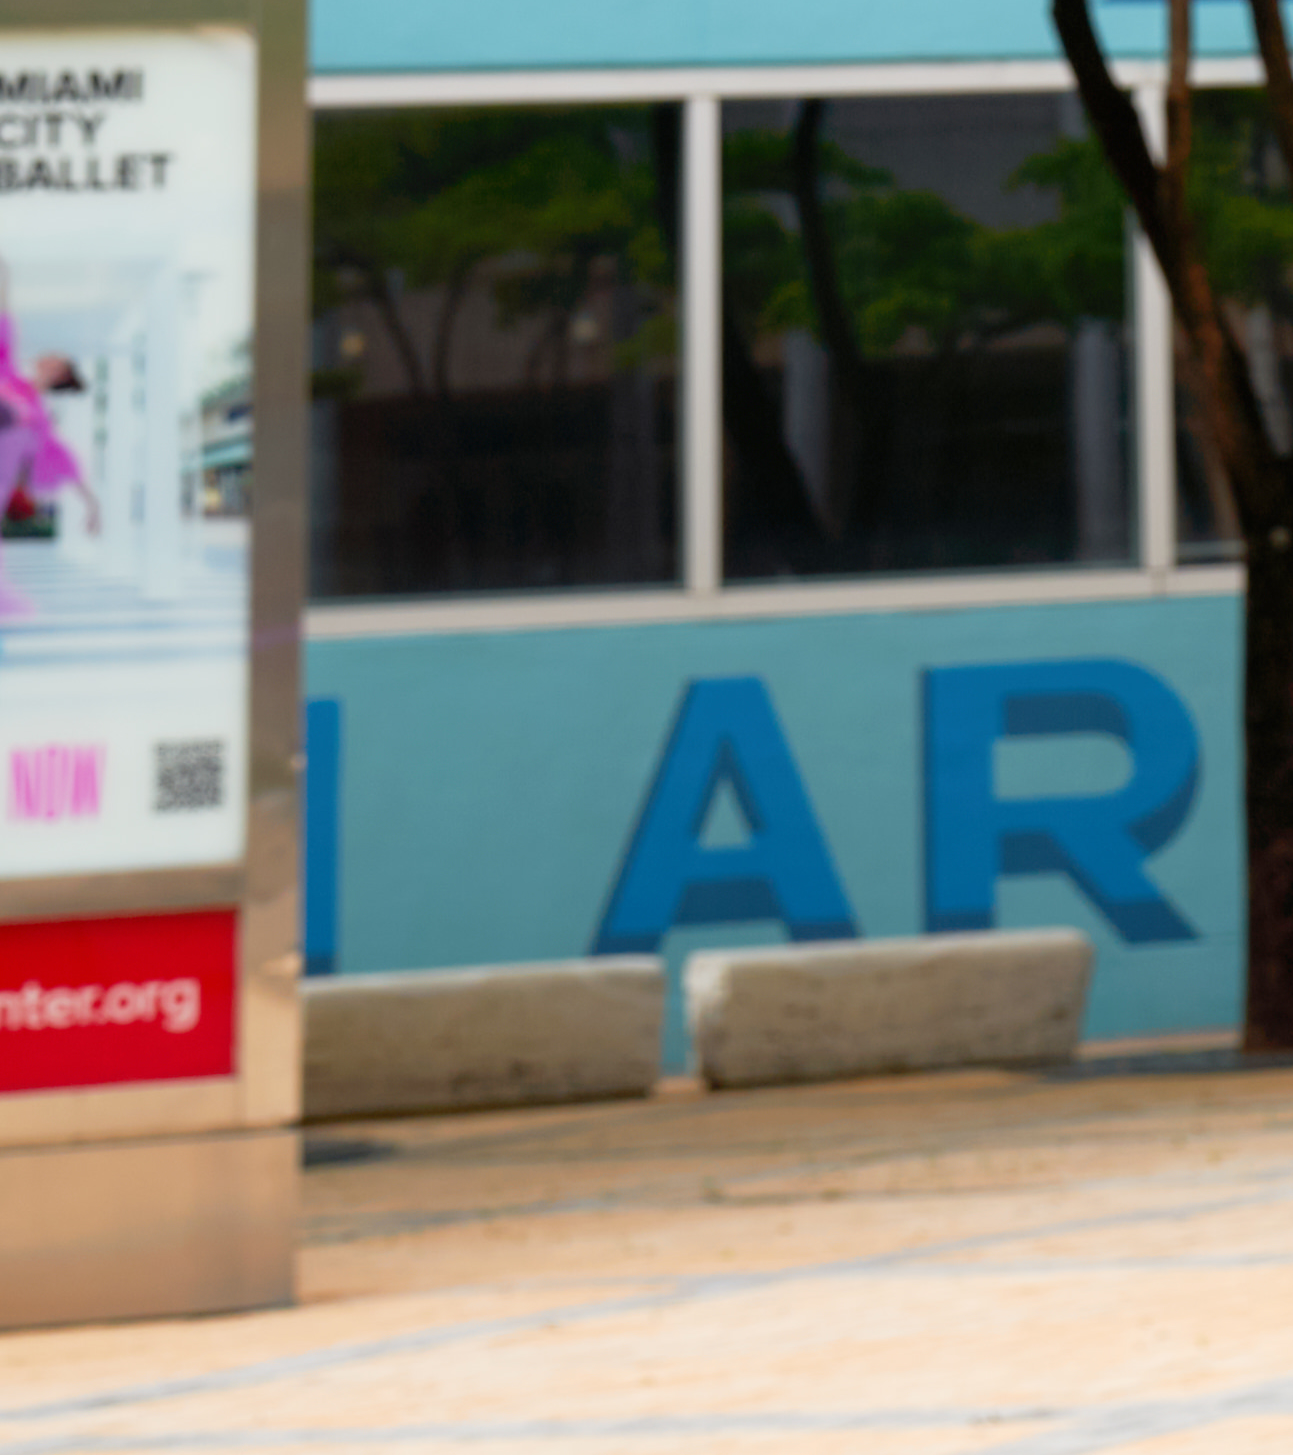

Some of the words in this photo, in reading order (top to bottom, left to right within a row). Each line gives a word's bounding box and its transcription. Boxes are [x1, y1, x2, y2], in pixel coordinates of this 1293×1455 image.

[0, 67, 146, 103] MIAMI
[0, 112, 106, 149] CITY
[0, 149, 174, 193] BALLET
